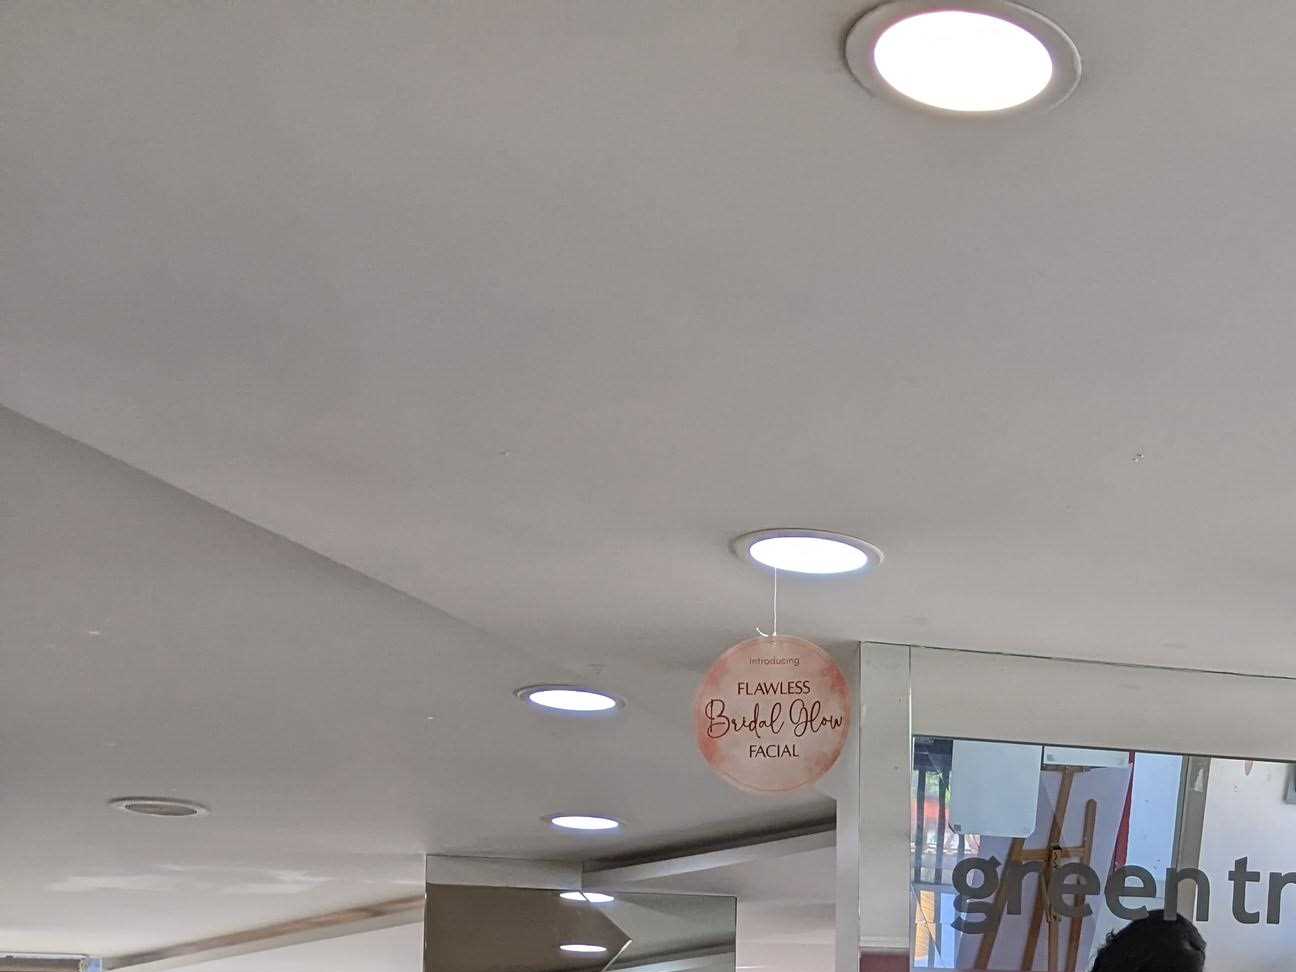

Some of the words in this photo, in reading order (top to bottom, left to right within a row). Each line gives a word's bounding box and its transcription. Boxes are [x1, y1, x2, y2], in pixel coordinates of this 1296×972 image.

[737, 680, 811, 696] FLAWLESS
[704, 699, 785, 739] Bridal
[789, 698, 843, 738] Glow
[748, 743, 800, 759] FACIAL
[951, 855, 1210, 934] green
